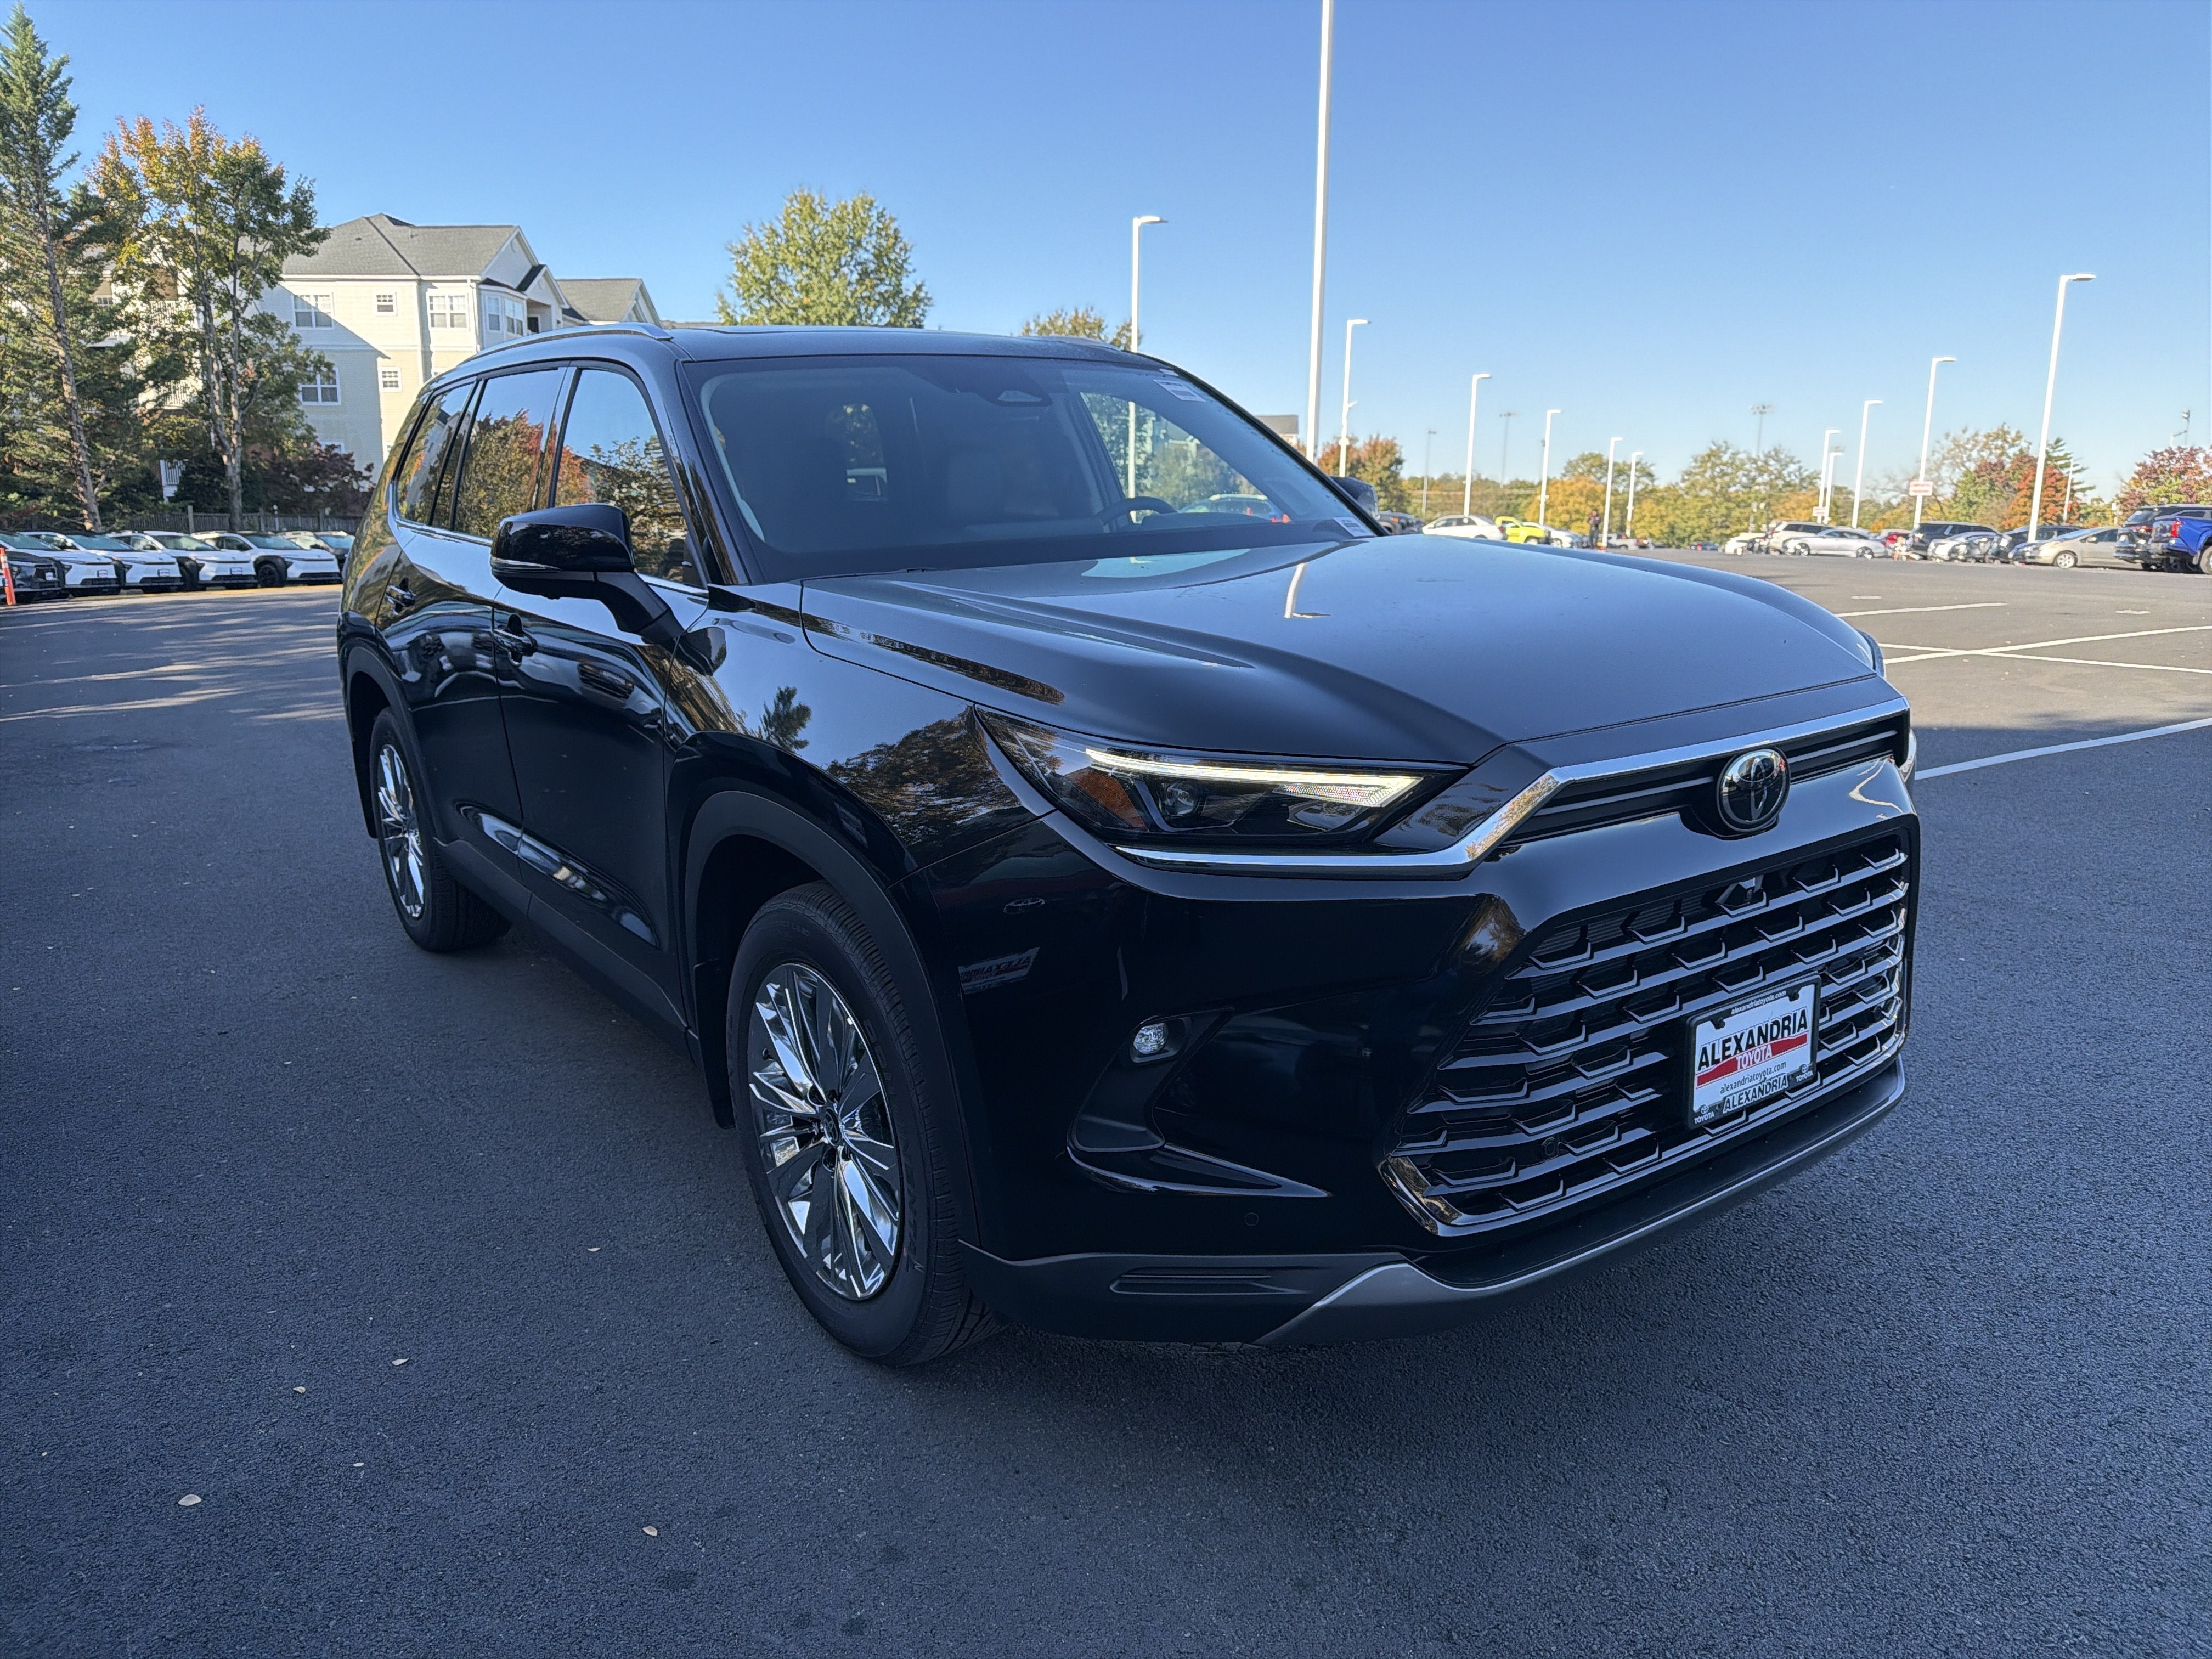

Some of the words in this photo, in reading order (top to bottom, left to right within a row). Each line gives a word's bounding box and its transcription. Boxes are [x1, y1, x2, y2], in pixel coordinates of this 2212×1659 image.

[1731, 991, 1787, 1015] alexandriatoyota.com
[1698, 1009, 1808, 1071] ALEXANDRIA
[1736, 1045, 1773, 1070] TOYOTA
[1720, 1062, 1786, 1094] alexandriatoyota.com
[1796, 1070, 1813, 1083] TOYOTA
[1723, 1074, 1788, 1113] ALEXANDRIA
[1694, 1111, 1715, 1124] TOYOTA
